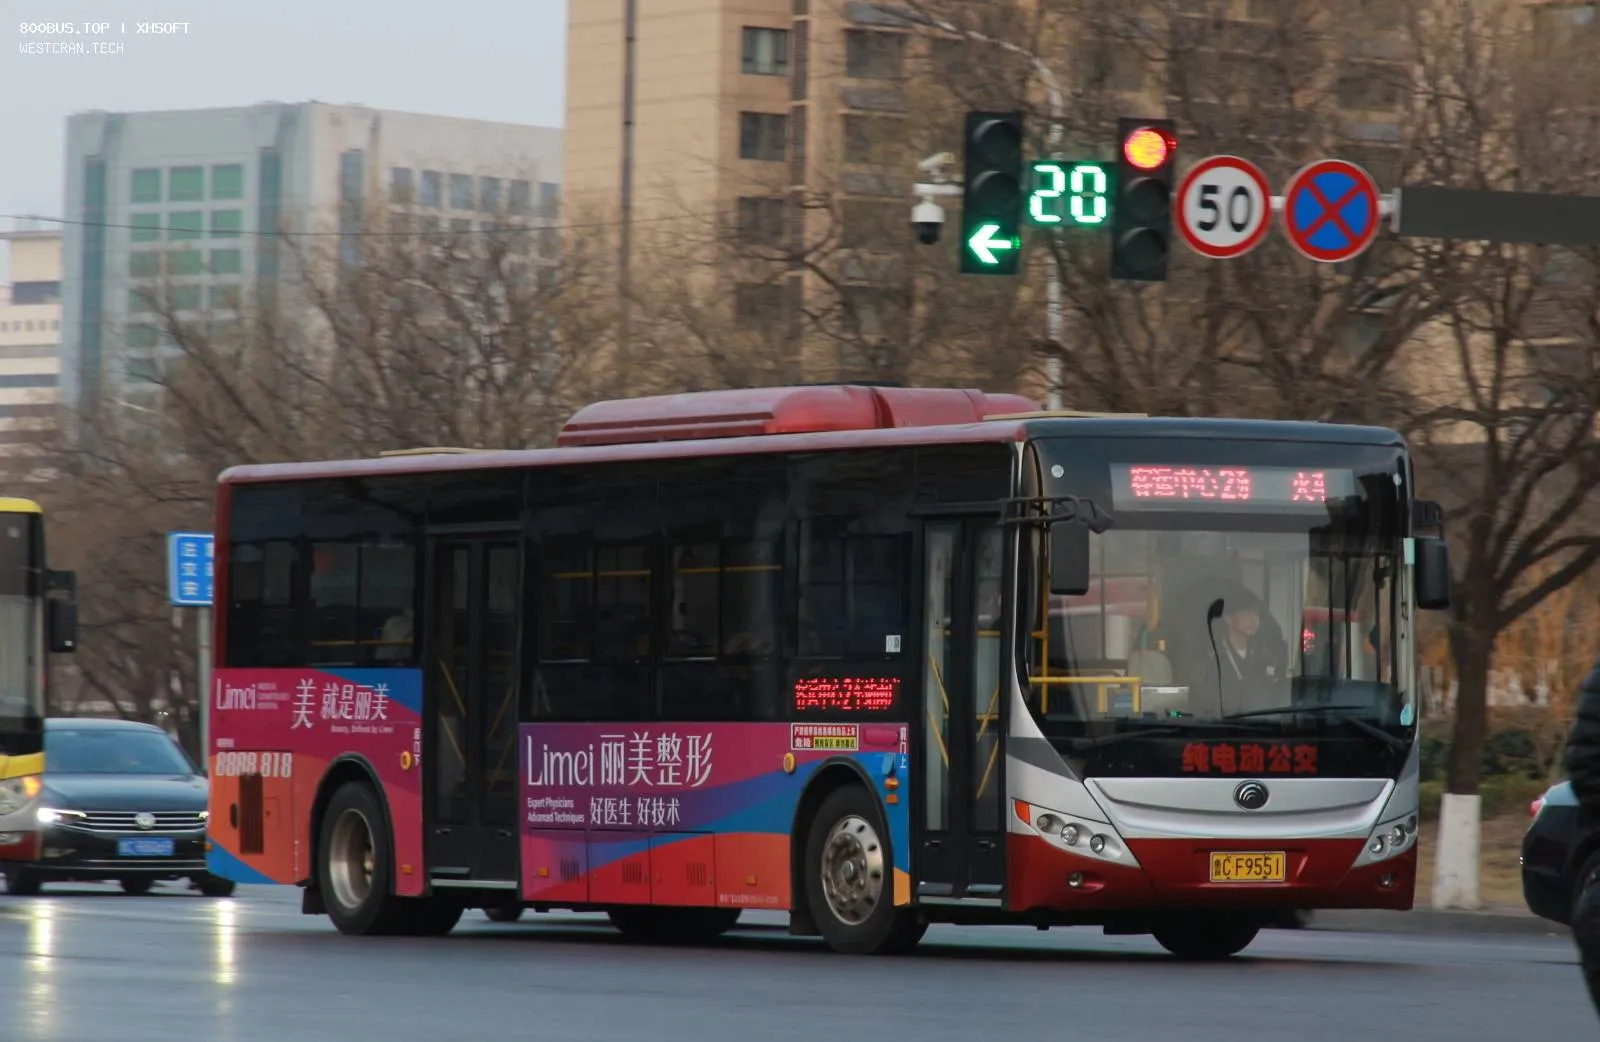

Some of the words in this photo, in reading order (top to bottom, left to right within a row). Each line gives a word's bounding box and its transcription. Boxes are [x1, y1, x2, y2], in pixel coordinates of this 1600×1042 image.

[1029, 165, 1107, 223] 20
[1197, 184, 1252, 232] 50
[216, 678, 256, 710] Limei
[290, 678, 316, 729] 美
[320, 682, 391, 721] 就是丽美
[527, 735, 594, 786] Limei
[600, 731, 713, 788] 丽美整形
[1182, 742, 1317, 773] 纯电动公交
[527, 797, 545, 810] Expert
[545, 796, 575, 810] Physicians
[527, 811, 554, 823] Advanced
[554, 811, 585, 825] Techniques
[590, 797, 633, 825] 好医生
[637, 797, 681, 826] 好技术
